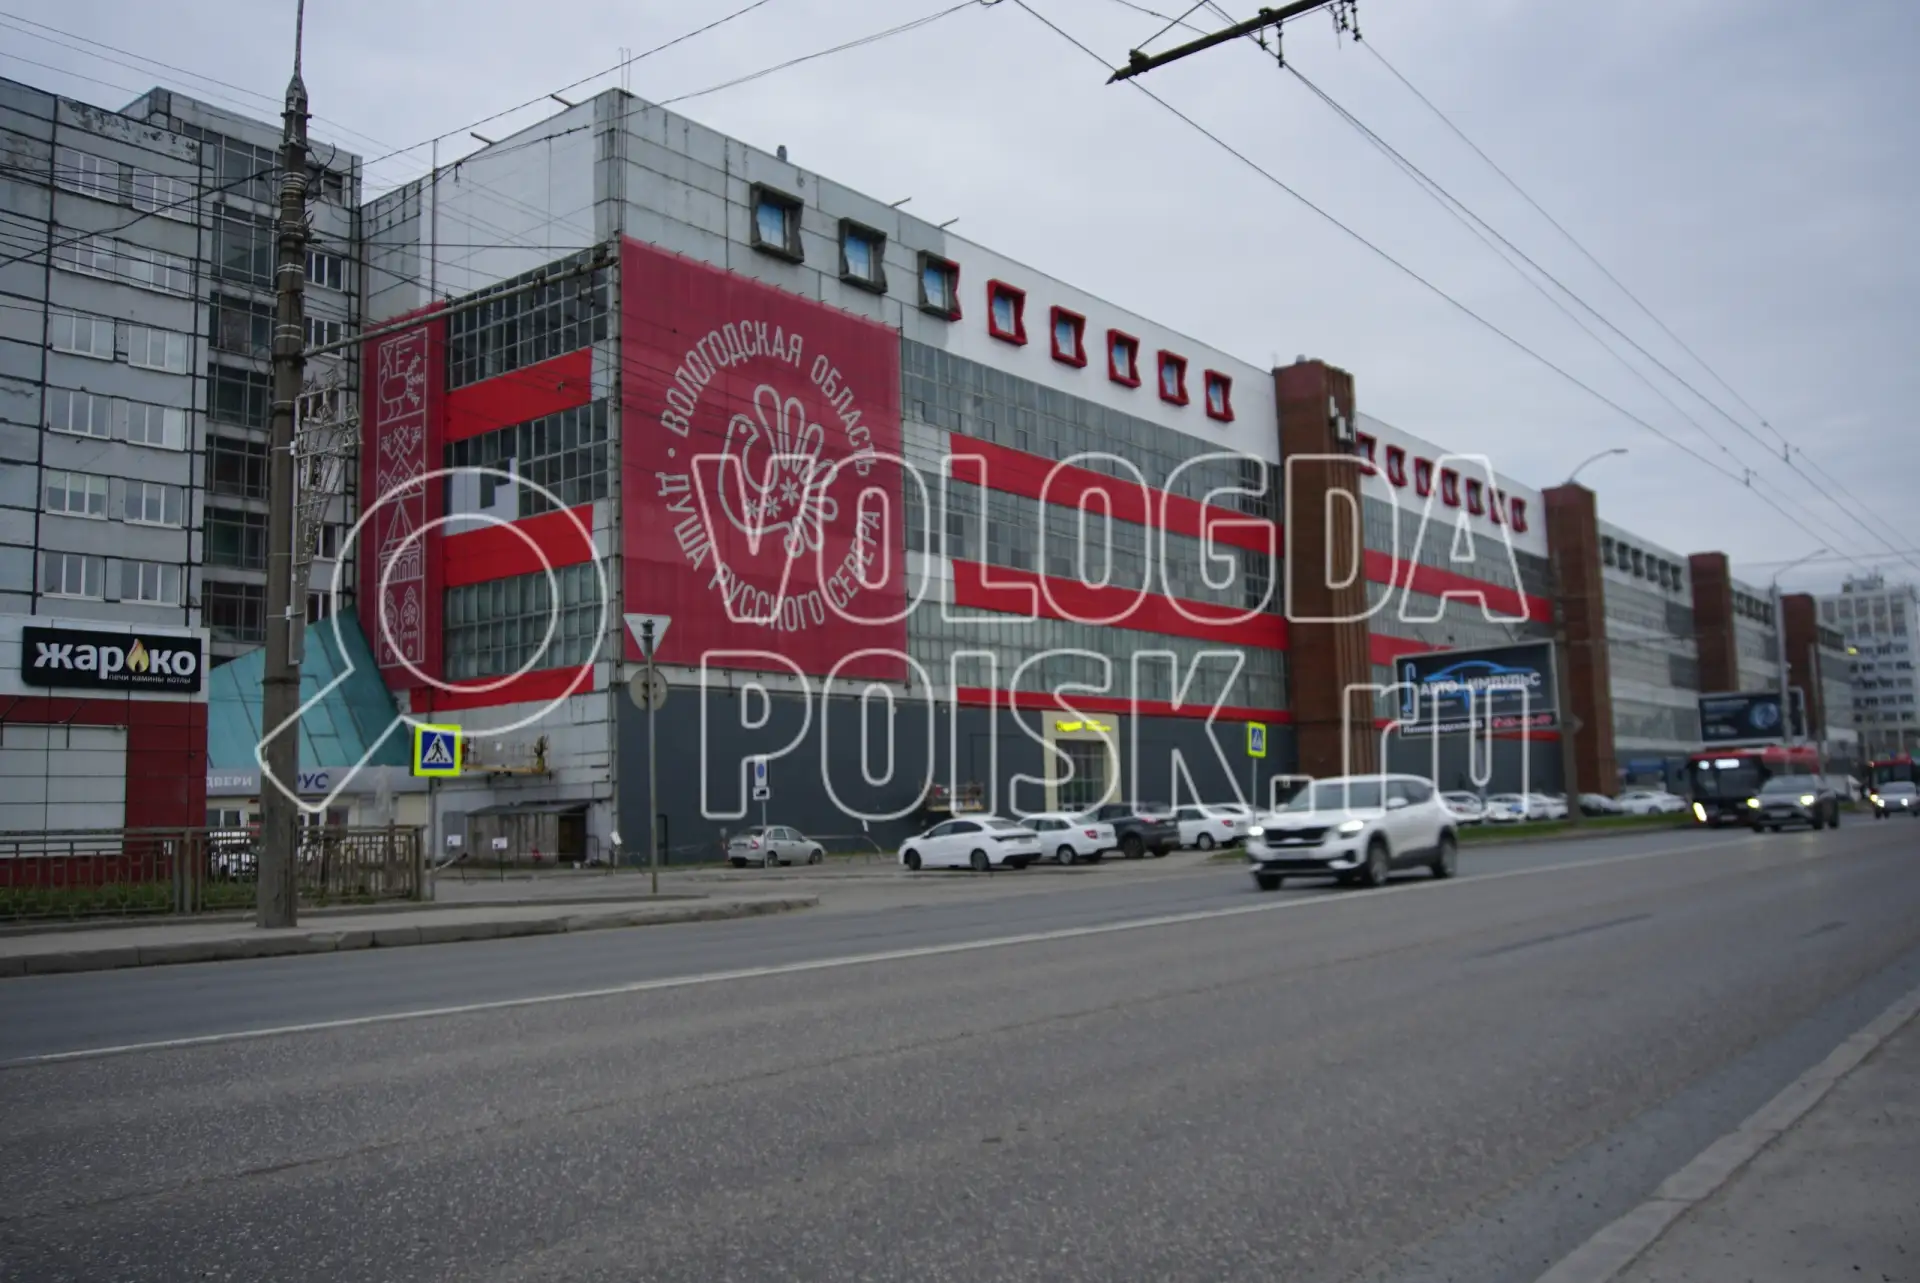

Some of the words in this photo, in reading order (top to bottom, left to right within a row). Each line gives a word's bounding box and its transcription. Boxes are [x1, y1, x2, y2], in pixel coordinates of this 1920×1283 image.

[660, 319, 804, 437] ВОЛОГОДСКАЯ
[810, 354, 877, 476] ОБЛАСТЬ
[655, 471, 713, 571] ДУША
[707, 562, 825, 632] РУССКОГО
[826, 511, 881, 609] СЕВЕРА
[132, 675, 164, 683] камины
[297, 773, 329, 789] УС
